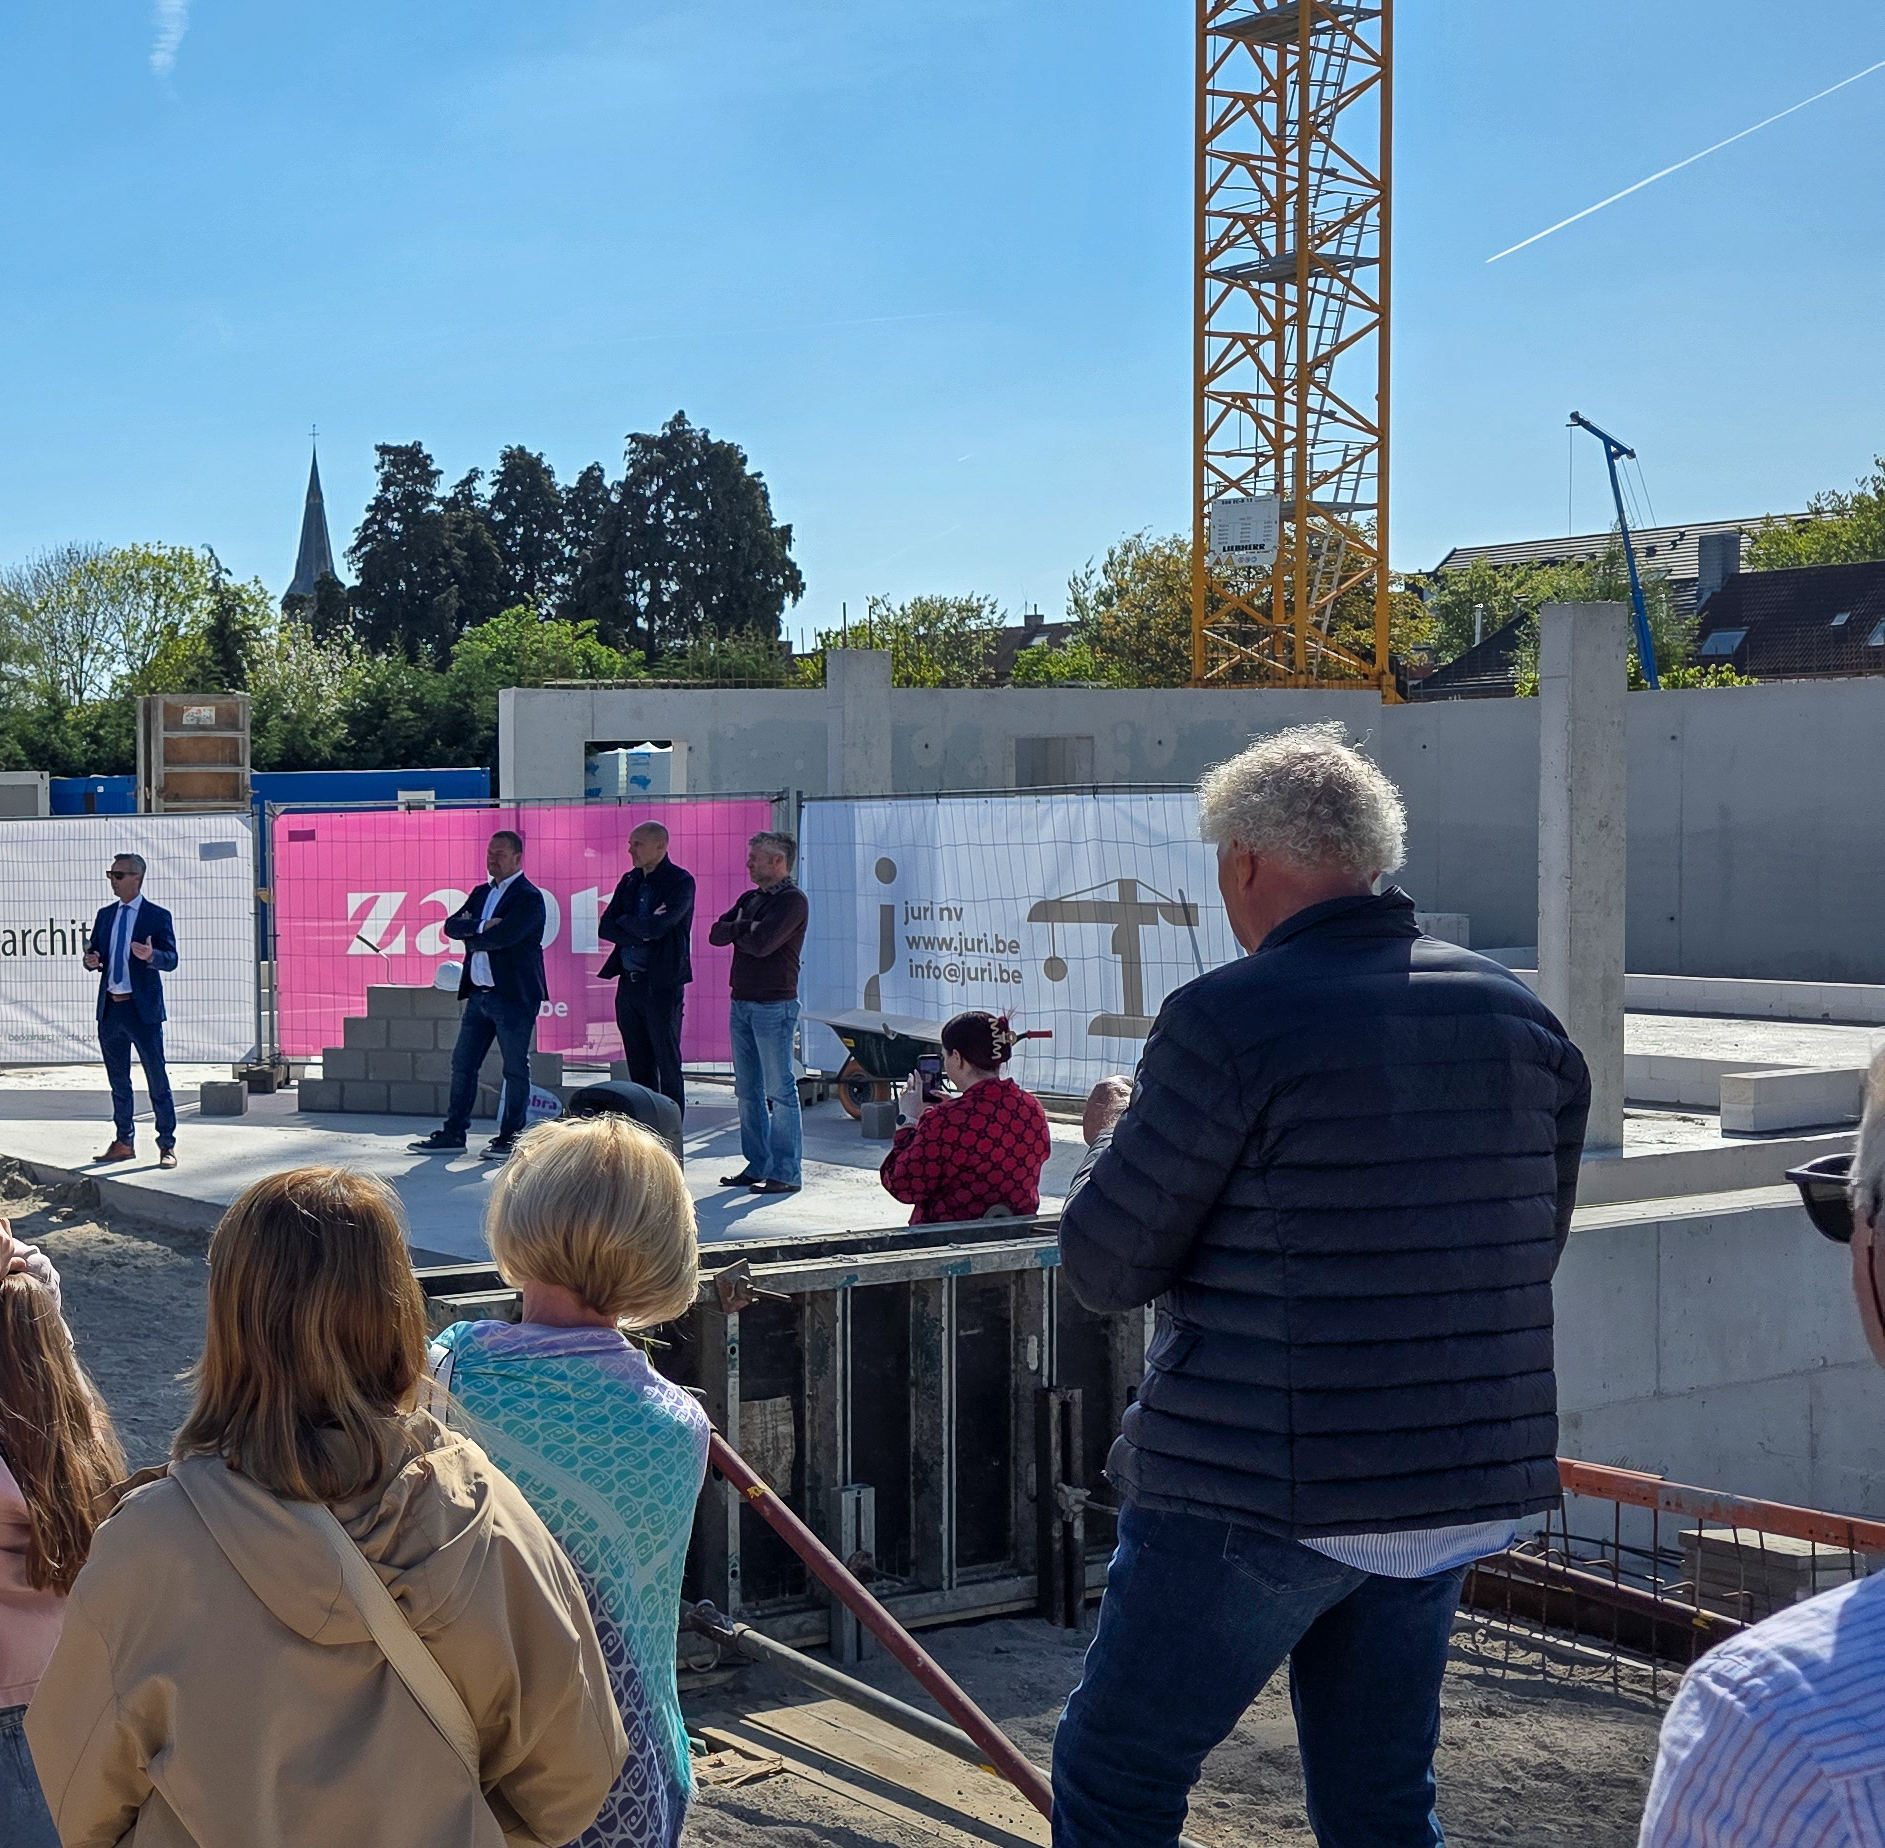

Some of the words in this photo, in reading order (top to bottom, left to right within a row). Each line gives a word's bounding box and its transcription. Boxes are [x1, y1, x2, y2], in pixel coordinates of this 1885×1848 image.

[1222, 543, 1266, 552] LIEBHERR
[903, 900, 934, 926] juri
[939, 906, 964, 922] nv
[905, 931, 1021, 957] www.juri.be
[908, 958, 1023, 987] info@juri.be
